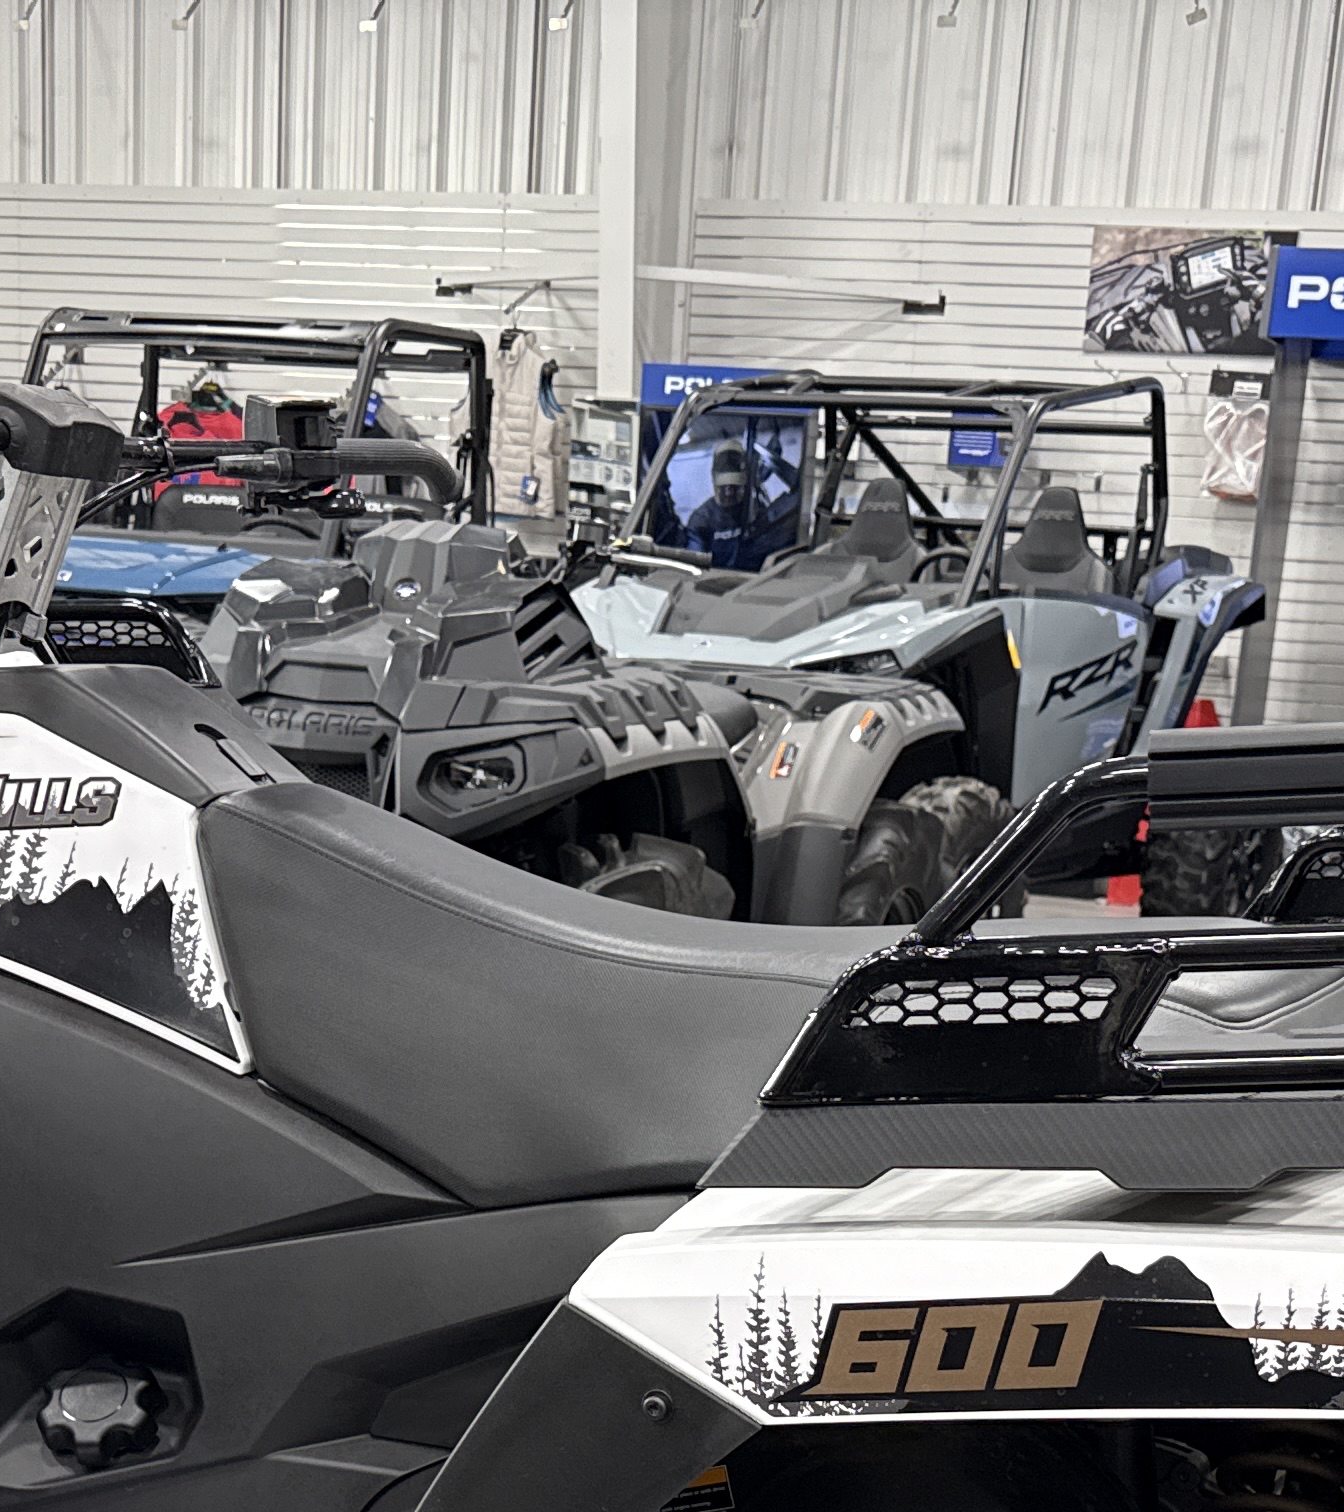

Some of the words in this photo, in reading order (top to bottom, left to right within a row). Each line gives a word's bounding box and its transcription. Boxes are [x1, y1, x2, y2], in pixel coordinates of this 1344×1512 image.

[182, 494, 240, 506] POLARIS
[1036, 640, 1138, 716] RZR
[250, 706, 378, 736] POLARIS
[800, 1300, 1103, 1396] 600
